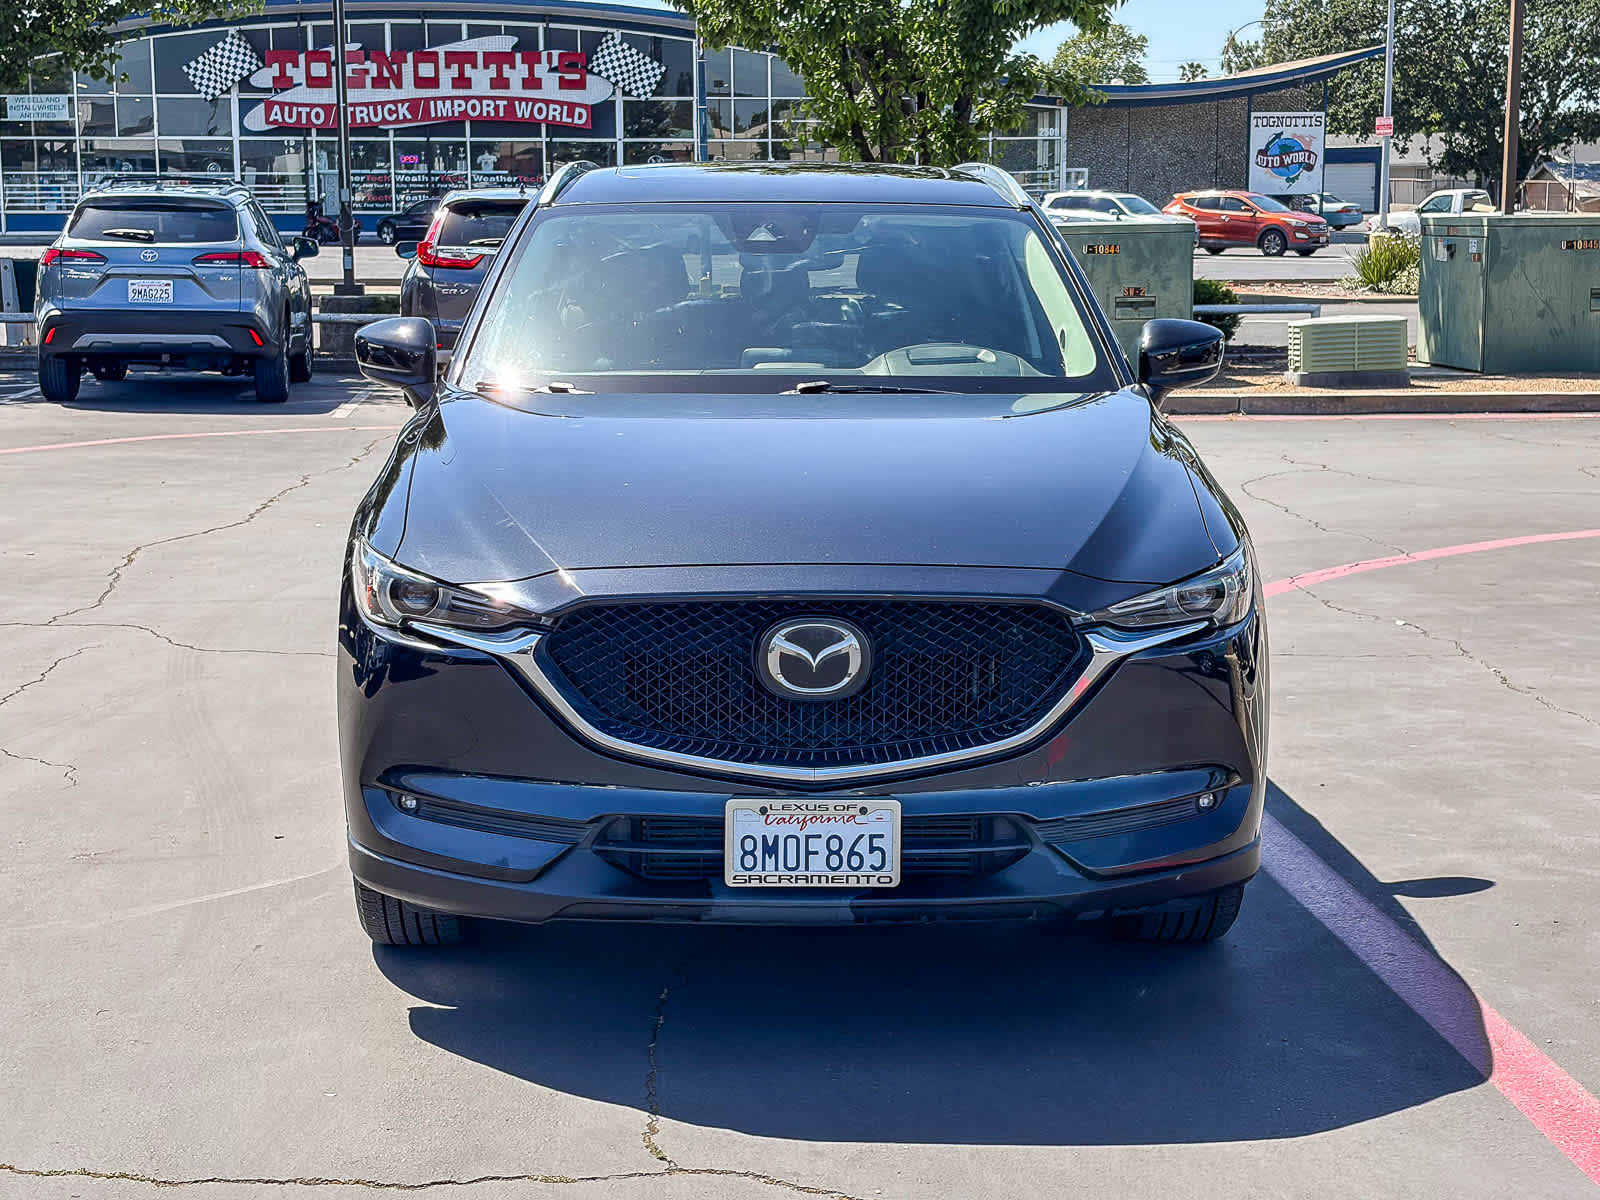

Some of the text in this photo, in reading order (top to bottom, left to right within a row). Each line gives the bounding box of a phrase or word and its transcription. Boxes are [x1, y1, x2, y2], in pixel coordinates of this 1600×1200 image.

[264, 50, 587, 90] TOGNOTTI'S
[269, 104, 326, 125] AUTO
[429, 99, 508, 119] IMPORT
[514, 100, 588, 125] WORLD
[1252, 113, 1323, 128] TOGNOTTI'S
[1282, 151, 1317, 166] WORLD
[131, 288, 171, 300] 9MAG225
[769, 803, 859, 812] LEXUS OF
[764, 814, 869, 831] California
[739, 833, 887, 872] 8MOF865
[732, 874, 894, 885] SACRAMENTO
